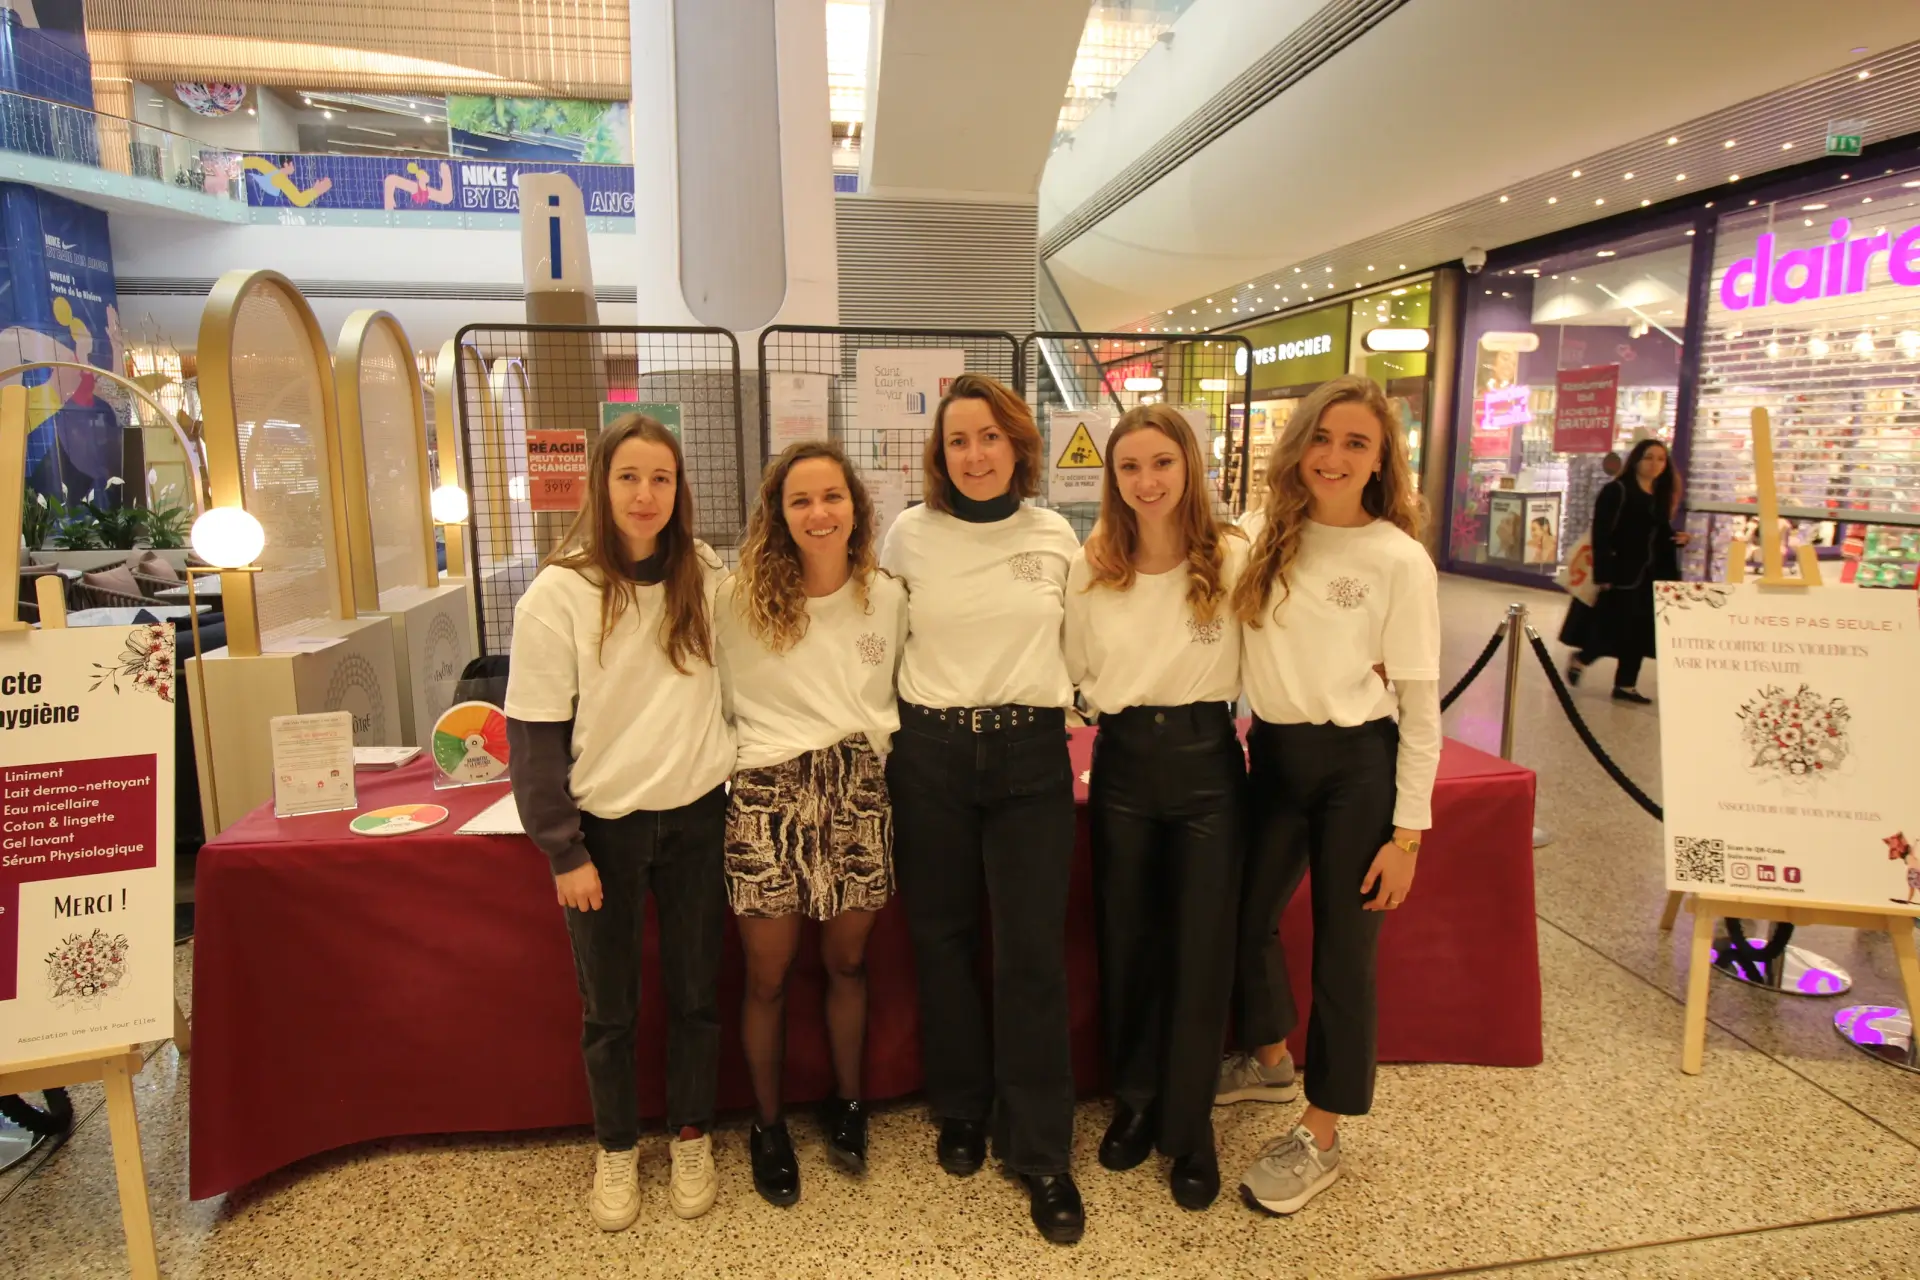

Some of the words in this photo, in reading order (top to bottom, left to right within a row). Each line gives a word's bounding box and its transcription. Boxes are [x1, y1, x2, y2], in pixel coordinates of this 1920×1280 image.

[462, 165, 508, 187] NIKE
[463, 188, 490, 209] BY
[590, 191, 635, 213] ANG
[50, 270, 70, 284] NIVEAU
[50, 283, 67, 295] Porte
[68, 286, 76, 296] de
[1278, 334, 1332, 361] ROCHER
[875, 366, 900, 377] Saint
[874, 377, 914, 388] Laurent
[886, 390, 902, 401] Var
[1558, 416, 1610, 430] GRATUITS
[528, 440, 585, 454] RÉAGIR
[530, 454, 556, 463] PEUT
[557, 454, 584, 463] TOUT
[530, 463, 587, 472] CHANGER
[544, 483, 572, 494] 3919
[1728, 615, 1749, 624] TU
[1796, 618, 1830, 629] PAS
[1836, 619, 1893, 632] SEULE
[1672, 637, 1714, 650] LUTTER
[1772, 642, 1795, 654] LES
[1673, 656, 1702, 669] AGIR
[1706, 658, 1740, 672] POUR
[352, 714, 371, 733] ÔTRE
[5, 768, 64, 782] Liniment
[4, 788, 30, 799] Lait
[33, 776, 150, 796] dermo-nettoyant
[4, 805, 28, 815] Eau
[33, 798, 99, 813] micellaire
[3, 821, 44, 832] Coton
[49, 817, 59, 827] &
[64, 812, 115, 827] lingette
[3, 837, 26, 849] Gel
[30, 833, 75, 846] lavant
[2, 854, 45, 866] Sérum
[50, 844, 144, 862] Physiologique
[122, 888, 126, 910] !
[17, 1032, 68, 1044] Association
[90, 1025, 108, 1033] Voix
[112, 1021, 130, 1029] Pour
[134, 1017, 156, 1026] Elles
